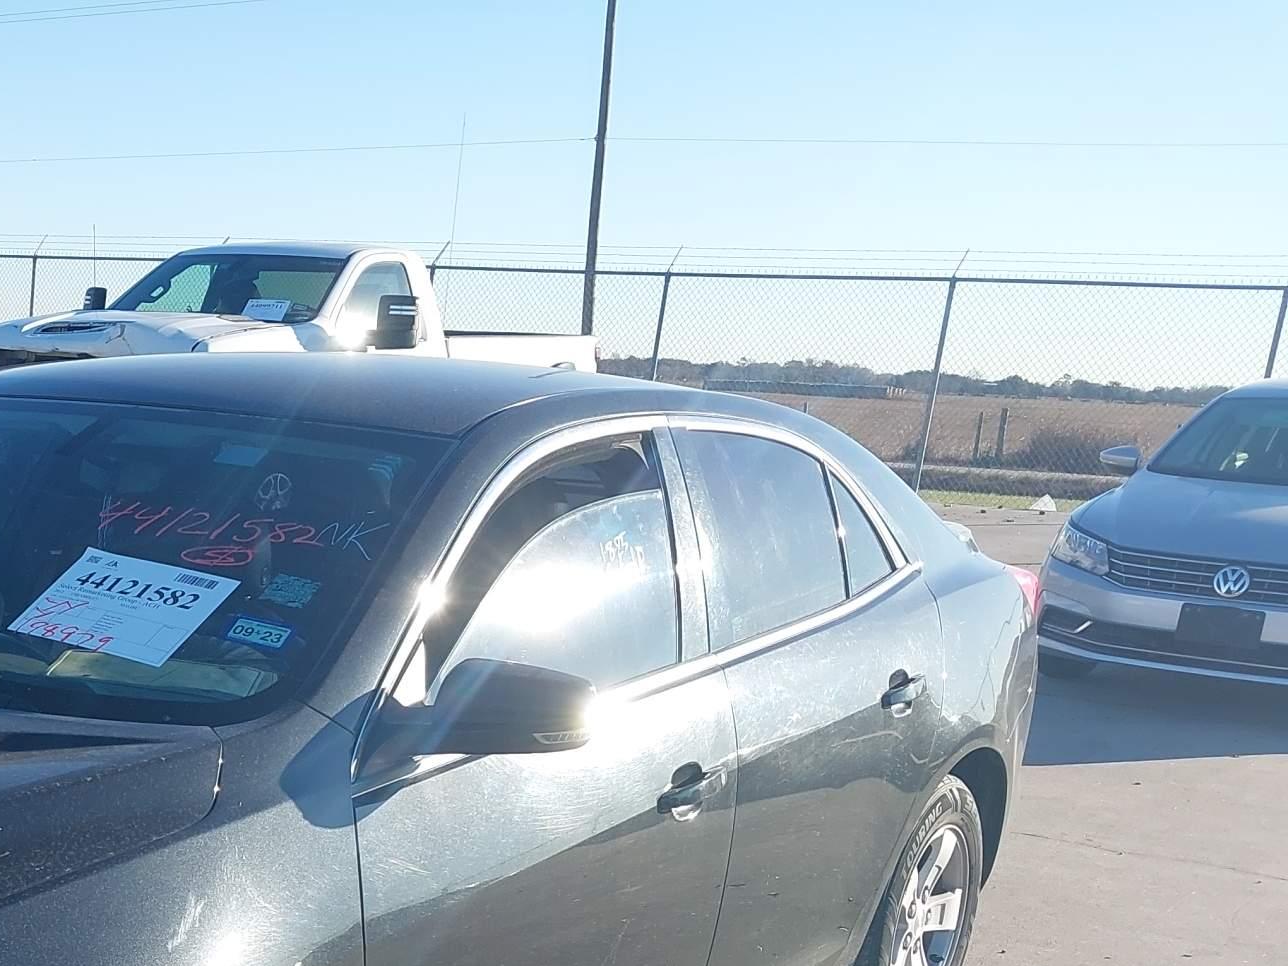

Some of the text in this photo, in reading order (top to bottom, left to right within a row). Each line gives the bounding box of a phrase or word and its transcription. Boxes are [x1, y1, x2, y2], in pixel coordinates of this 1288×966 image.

[76, 571, 201, 610] 44121582
[232, 624, 283, 644] 09 23
[900, 800, 944, 881] TOURING
